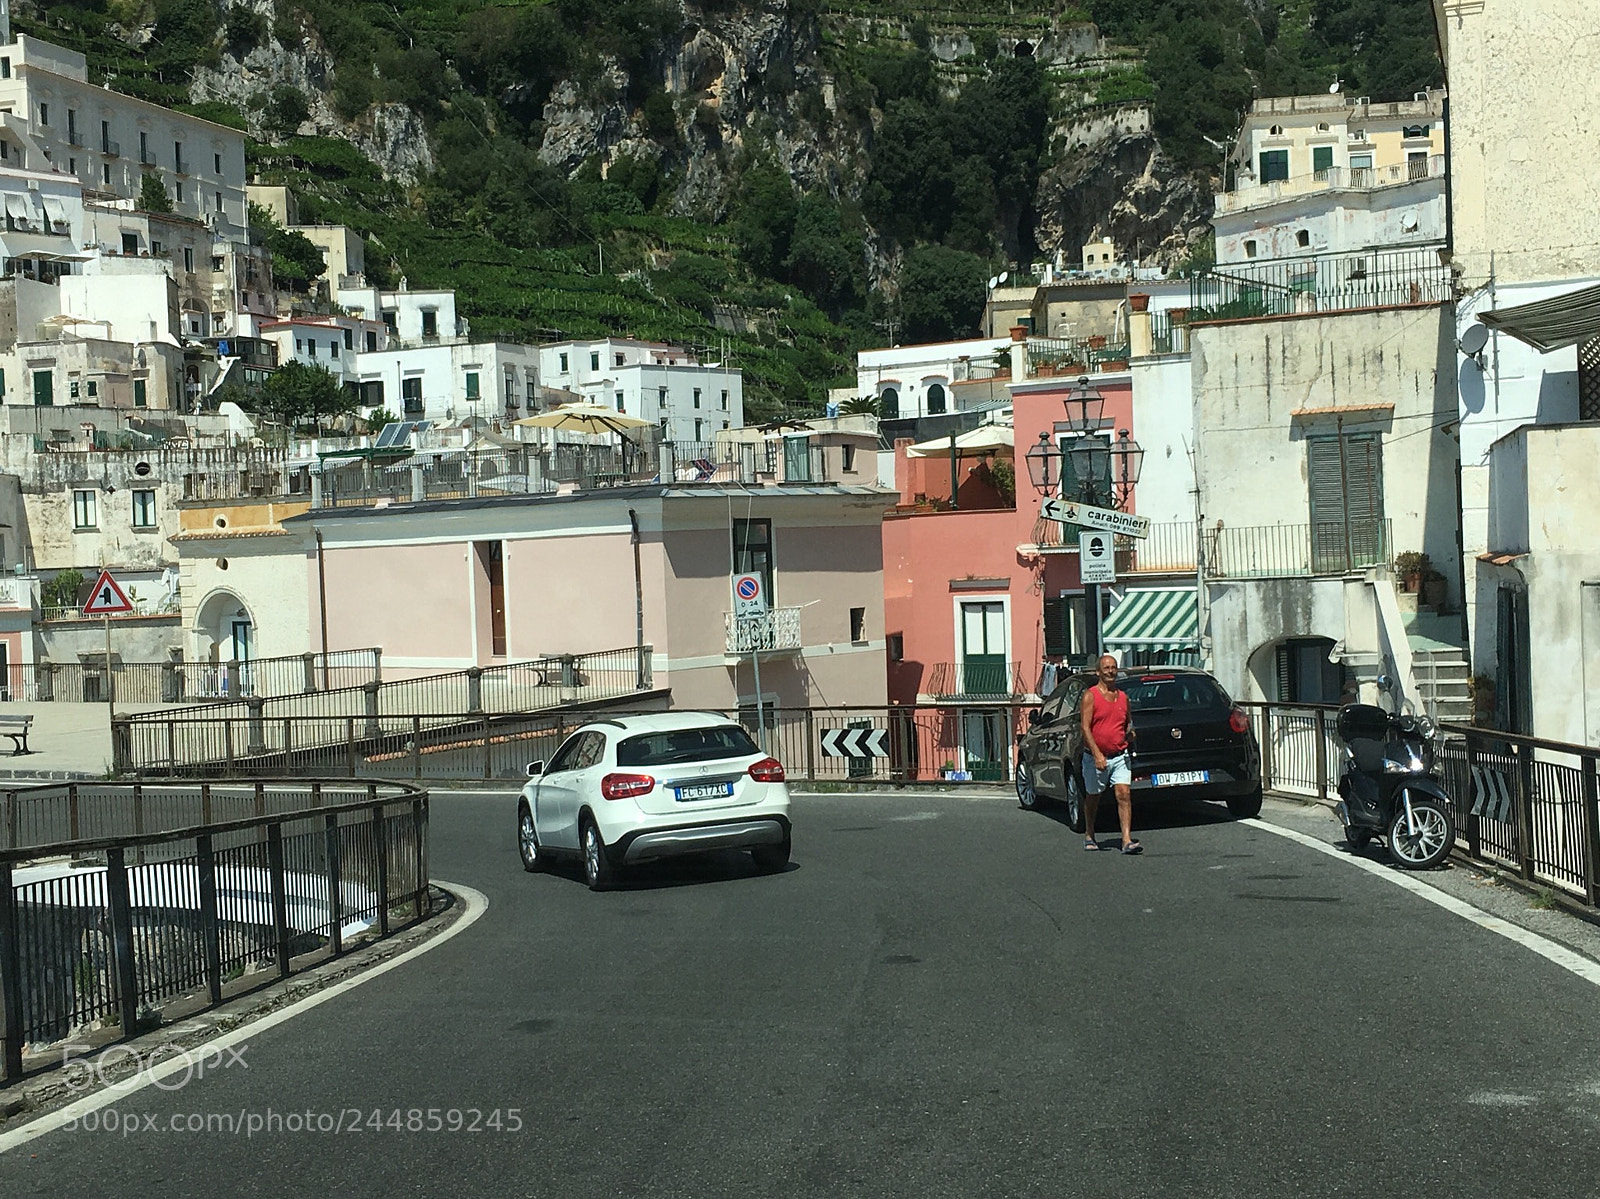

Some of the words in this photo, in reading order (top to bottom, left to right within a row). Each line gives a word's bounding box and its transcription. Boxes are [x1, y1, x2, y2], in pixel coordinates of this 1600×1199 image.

[1087, 510, 1148, 529] carabinieri
[1159, 773, 1170, 784] DW
[1174, 771, 1202, 782] 781PY
[682, 787, 694, 798] FC
[697, 783, 727, 797] 617XC
